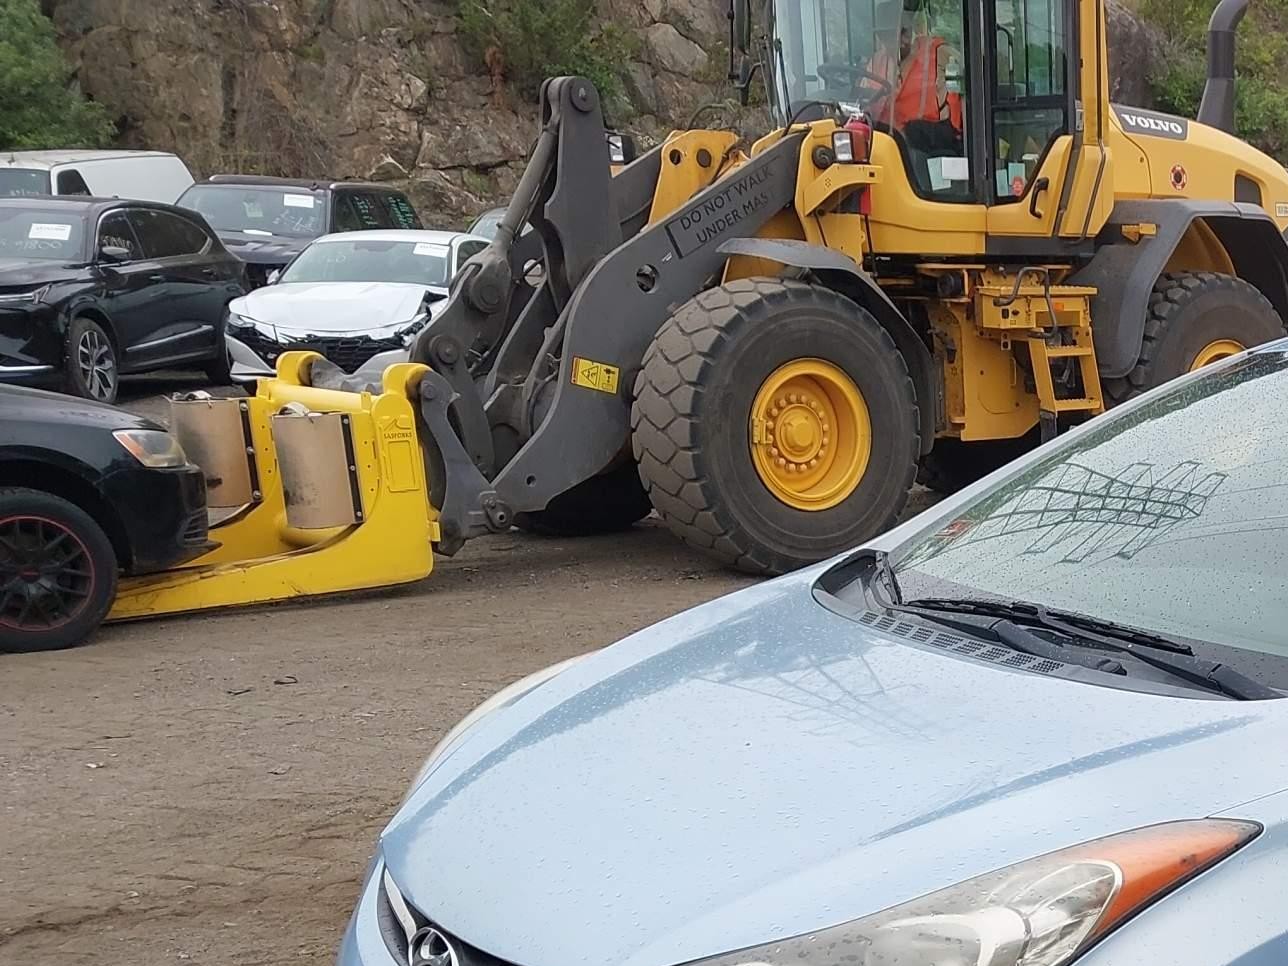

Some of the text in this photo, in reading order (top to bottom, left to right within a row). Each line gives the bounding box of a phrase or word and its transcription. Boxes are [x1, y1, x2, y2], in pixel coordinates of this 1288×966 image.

[1121, 113, 1183, 135] VOLVO
[680, 166, 774, 230] DO NOT WALK
[696, 190, 774, 243] UNDER MAS
